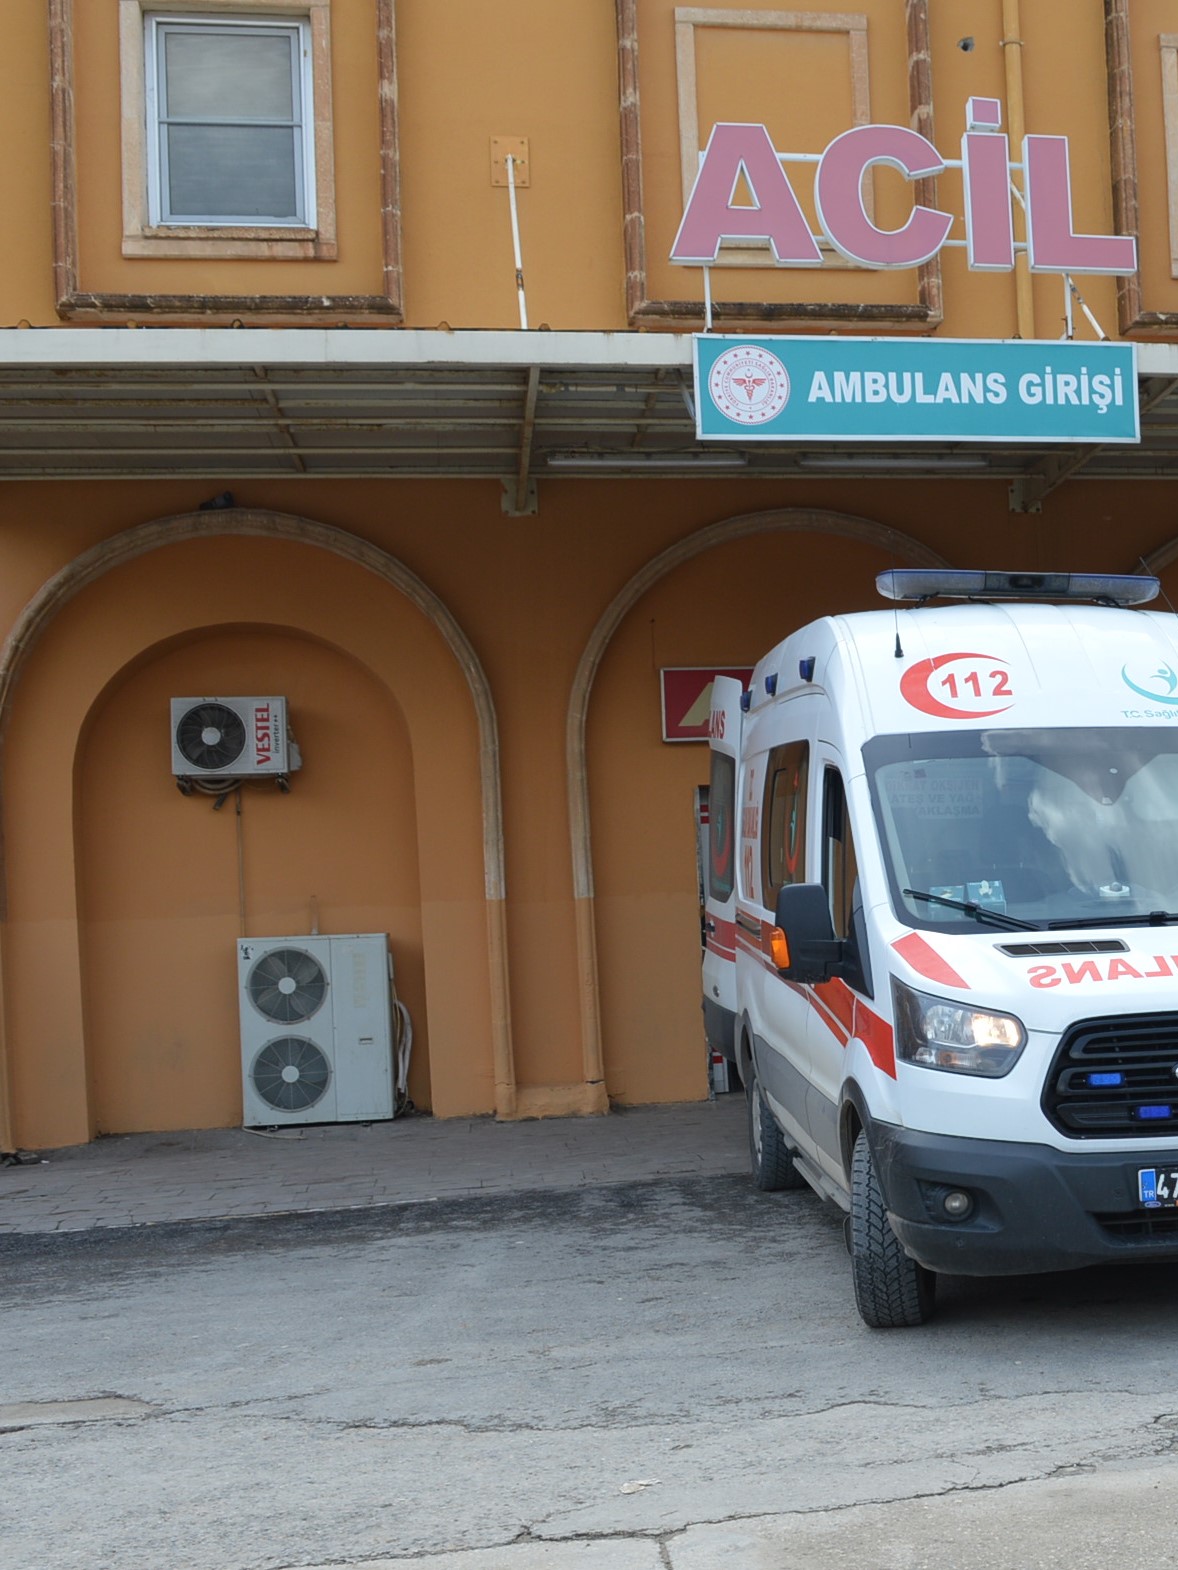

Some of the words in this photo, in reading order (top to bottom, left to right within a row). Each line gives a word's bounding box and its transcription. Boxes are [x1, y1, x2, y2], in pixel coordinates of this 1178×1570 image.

[669, 96, 1137, 276] ACİL
[807, 370, 1008, 405] AMBULANS
[1018, 366, 1124, 414] GİRİŞİ
[941, 670, 1014, 698] 112
[255, 703, 272, 765] VESTEL
[272, 724, 280, 754] inverter
[918, 805, 980, 817] AKLAŞMA
[928, 793, 945, 803] VE
[1143, 1190, 1155, 1198] TR
